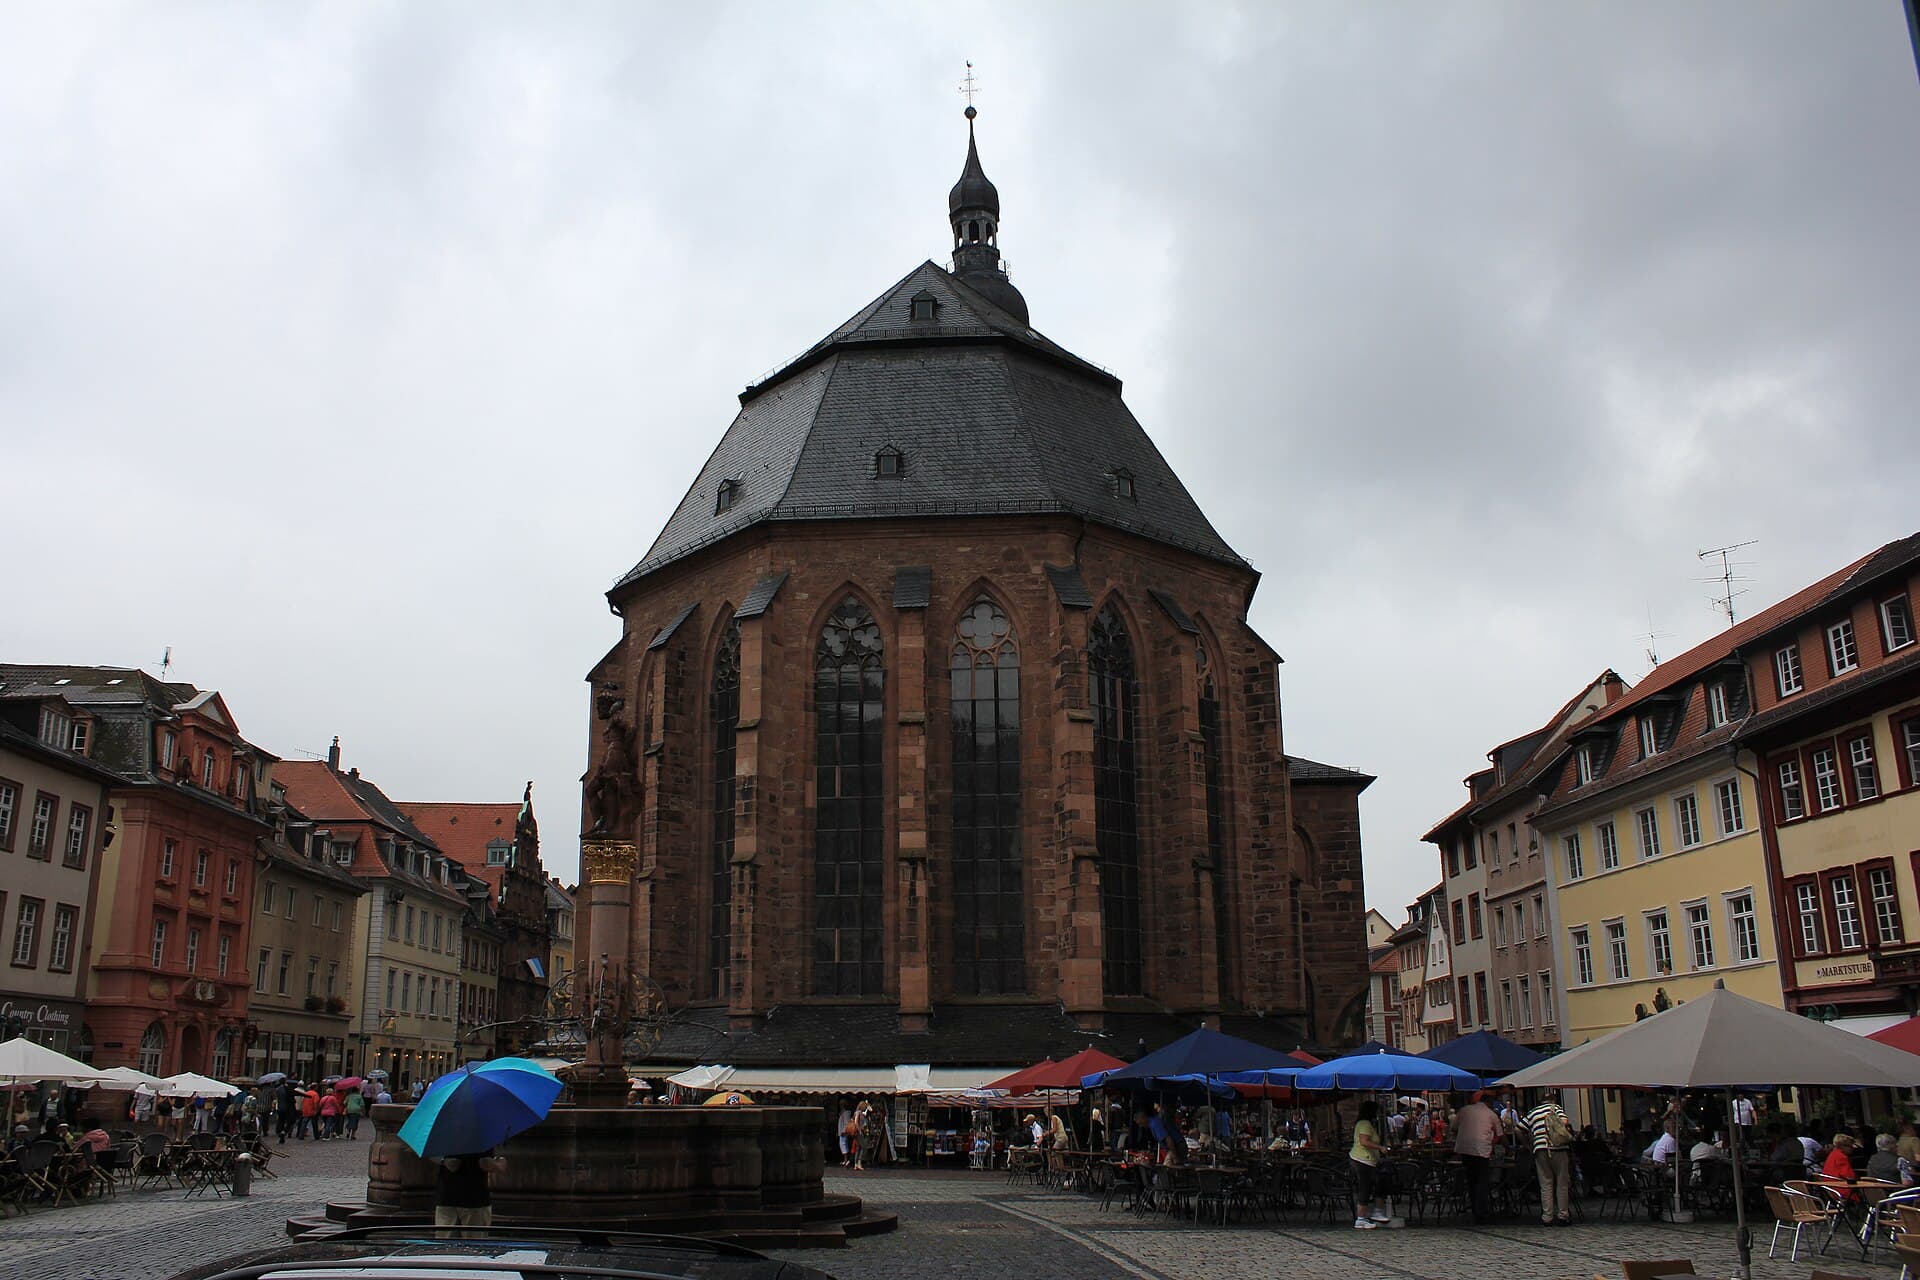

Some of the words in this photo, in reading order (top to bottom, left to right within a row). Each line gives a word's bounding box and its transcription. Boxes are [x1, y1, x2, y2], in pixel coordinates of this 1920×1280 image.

[1821, 962, 1873, 977] MARKTSTUBE
[1, 1001, 34, 1023] Country
[37, 1004, 70, 1026] Clothing
